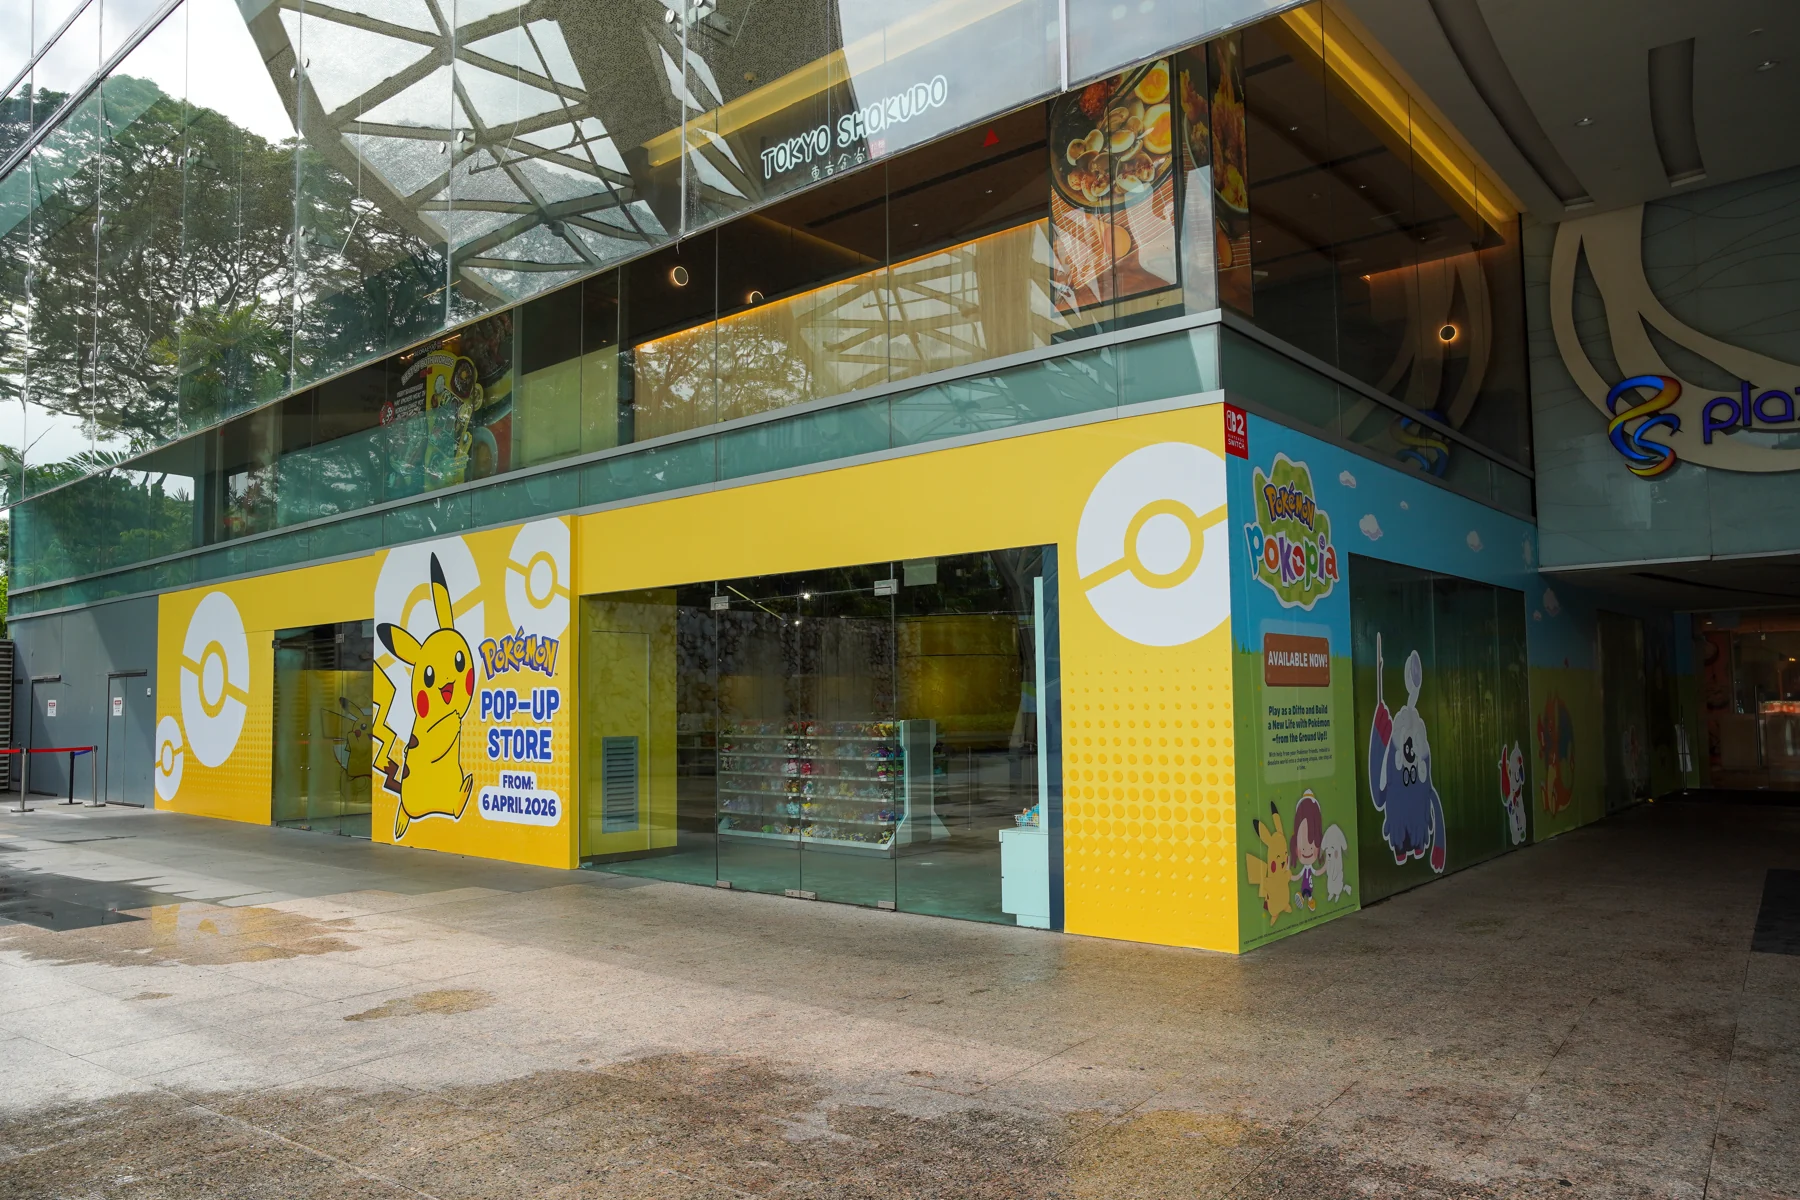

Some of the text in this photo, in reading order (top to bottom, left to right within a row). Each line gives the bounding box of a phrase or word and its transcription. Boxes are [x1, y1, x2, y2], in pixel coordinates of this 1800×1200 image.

[761, 75, 948, 179] TOKYO SHOKUDO
[1702, 381, 1800, 445] pla
[1228, 438, 1245, 449] SWITCH
[1268, 650, 1328, 668] AVAILABLE NOW!
[481, 689, 560, 720] POP-UP
[1268, 705, 1280, 718] Play
[1281, 707, 1288, 715] as
[1292, 704, 1305, 715] Ditto
[1305, 705, 1315, 715] and
[1315, 704, 1328, 714] Build
[1267, 717, 1330, 730] a New Life with Pokémon
[488, 728, 552, 760] STORE
[1289, 732, 1298, 743] the
[1299, 732, 1317, 743] Ground
[502, 774, 534, 791] FROM:
[482, 793, 557, 817] 6 APRIL 2026
